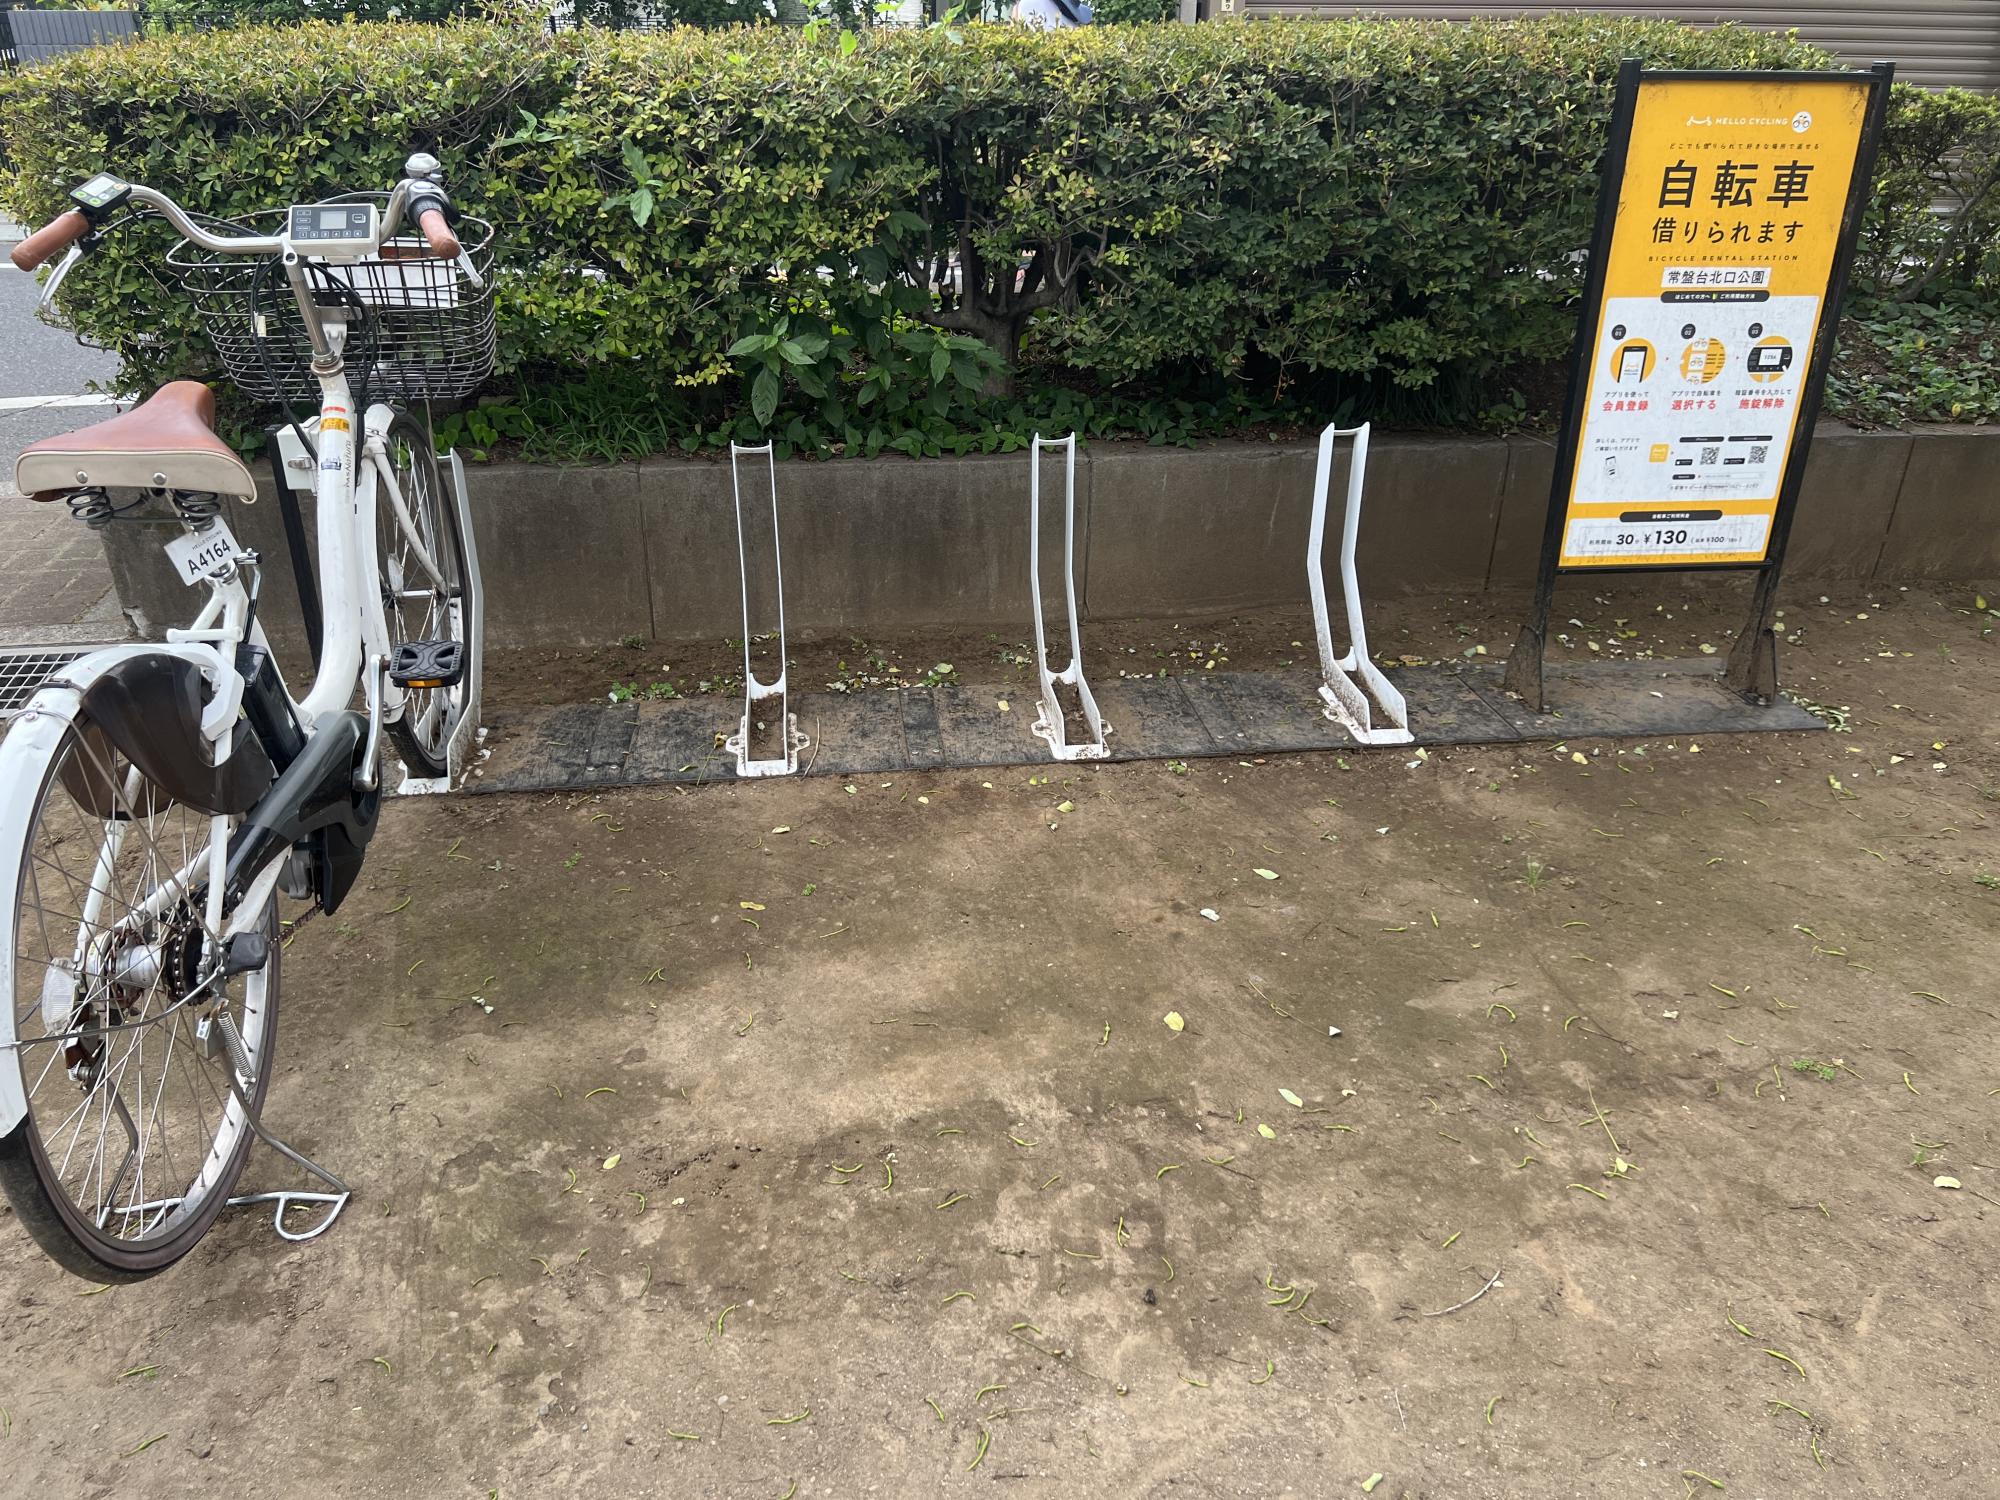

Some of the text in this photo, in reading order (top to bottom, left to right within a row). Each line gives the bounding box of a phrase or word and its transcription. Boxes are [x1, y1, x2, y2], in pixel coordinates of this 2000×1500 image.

[1715, 117, 1789, 126] HELLO CYCLING
[1658, 159, 1814, 209] 自転車
[1652, 216, 1804, 244] 借りられます
[1668, 270, 1765, 284] 常盤台北口公園
[1602, 400, 1649, 411] 会員登録
[1671, 399, 1717, 410] 選択する
[188, 538, 231, 575] A4164
